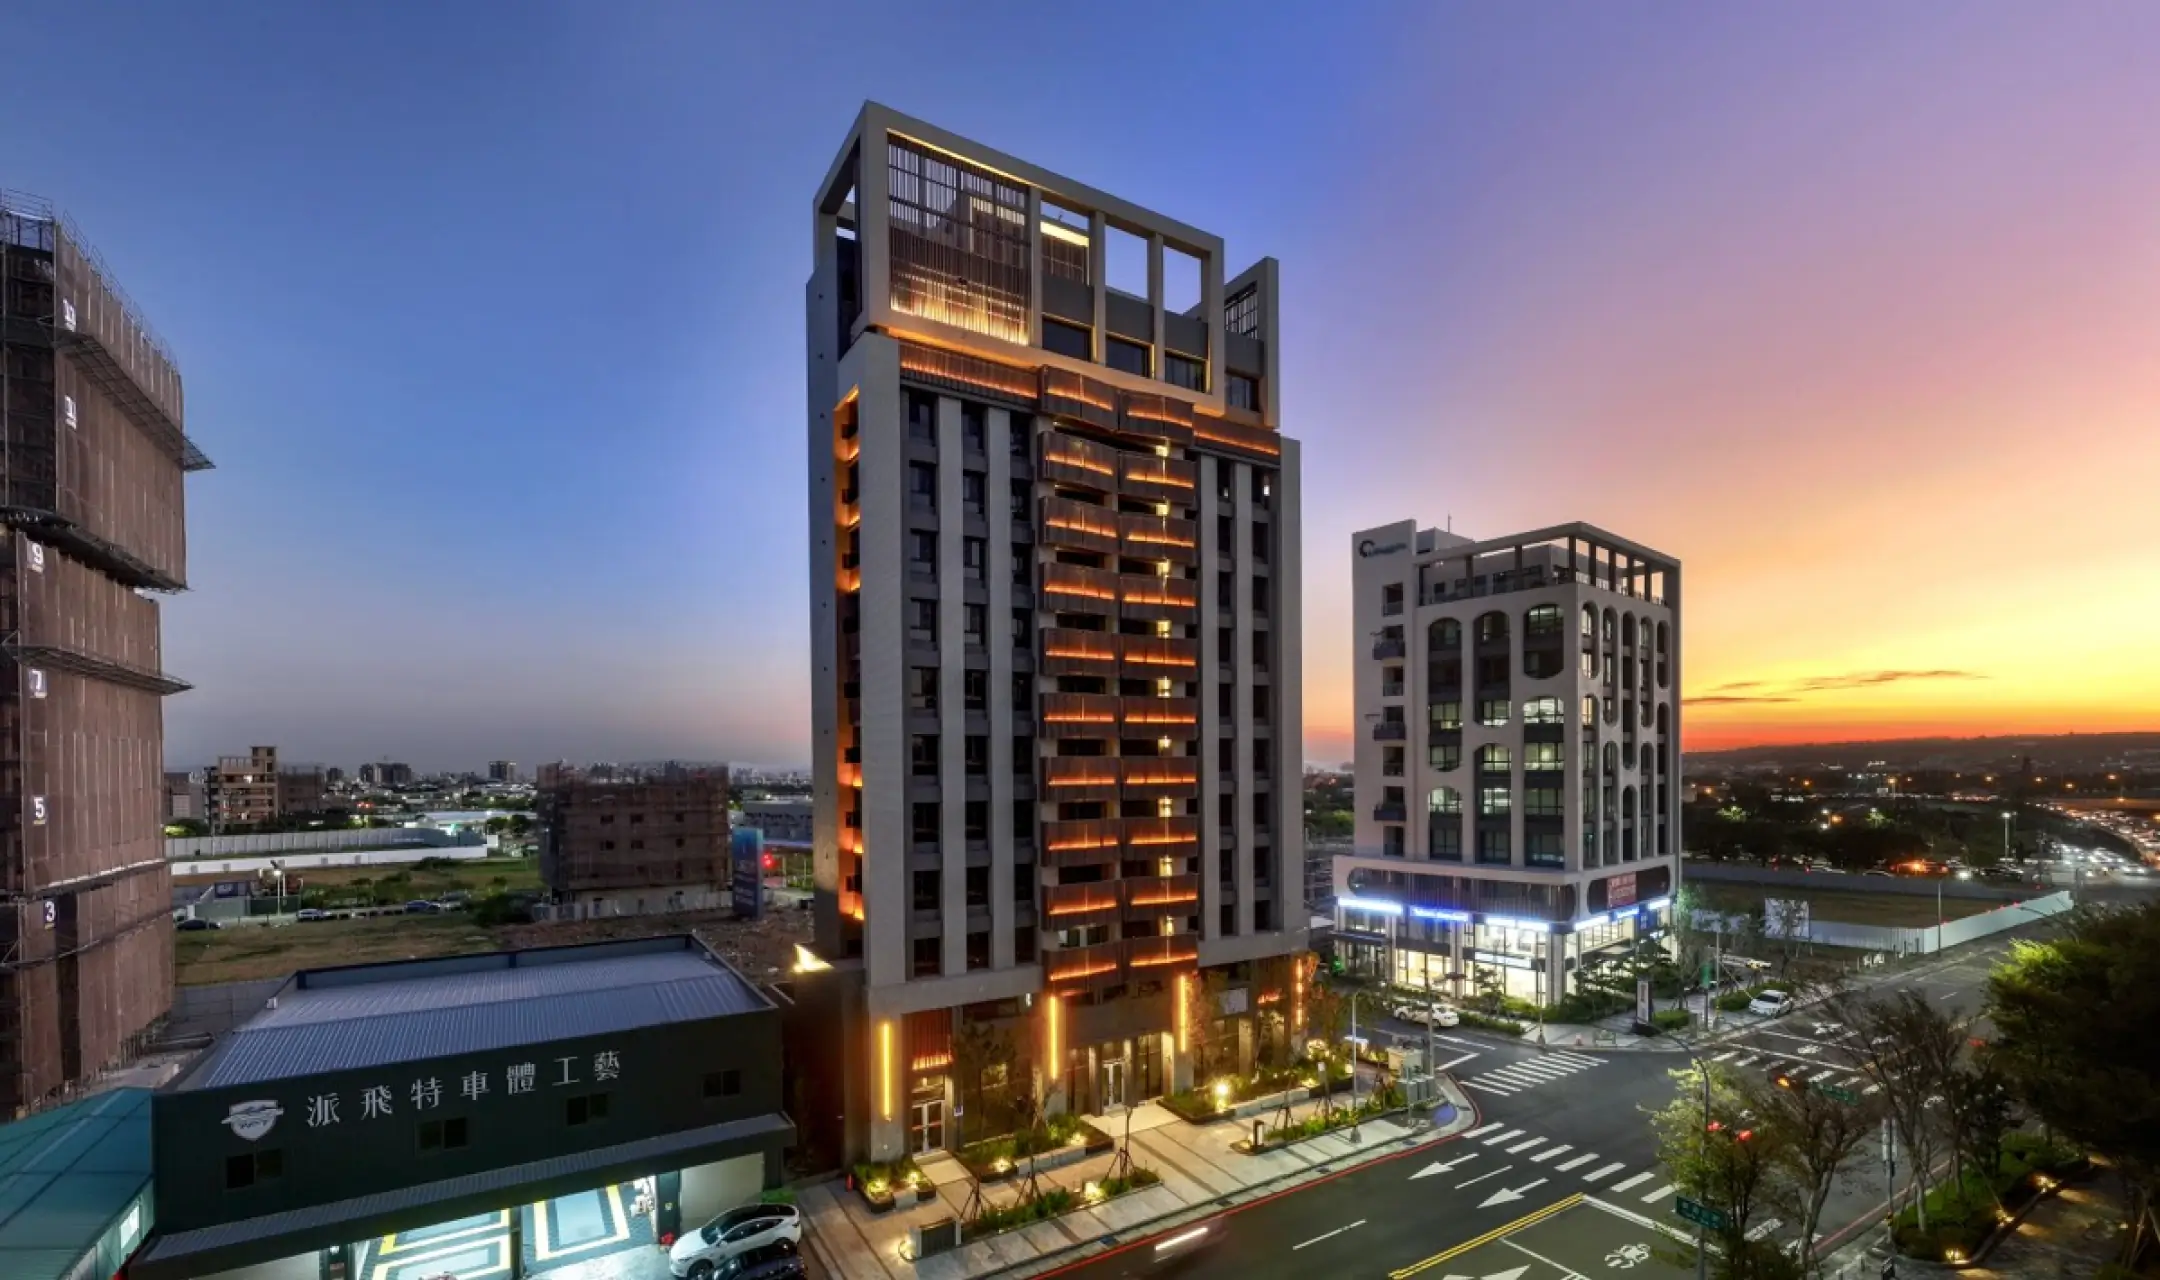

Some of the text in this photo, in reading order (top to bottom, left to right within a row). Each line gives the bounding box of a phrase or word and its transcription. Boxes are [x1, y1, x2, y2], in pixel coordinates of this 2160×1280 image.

[31, 542, 44, 565] 9
[33, 796, 46, 818] 5
[44, 900, 56, 922] 3
[306, 1050, 621, 1128] 派飛特車體工藝
